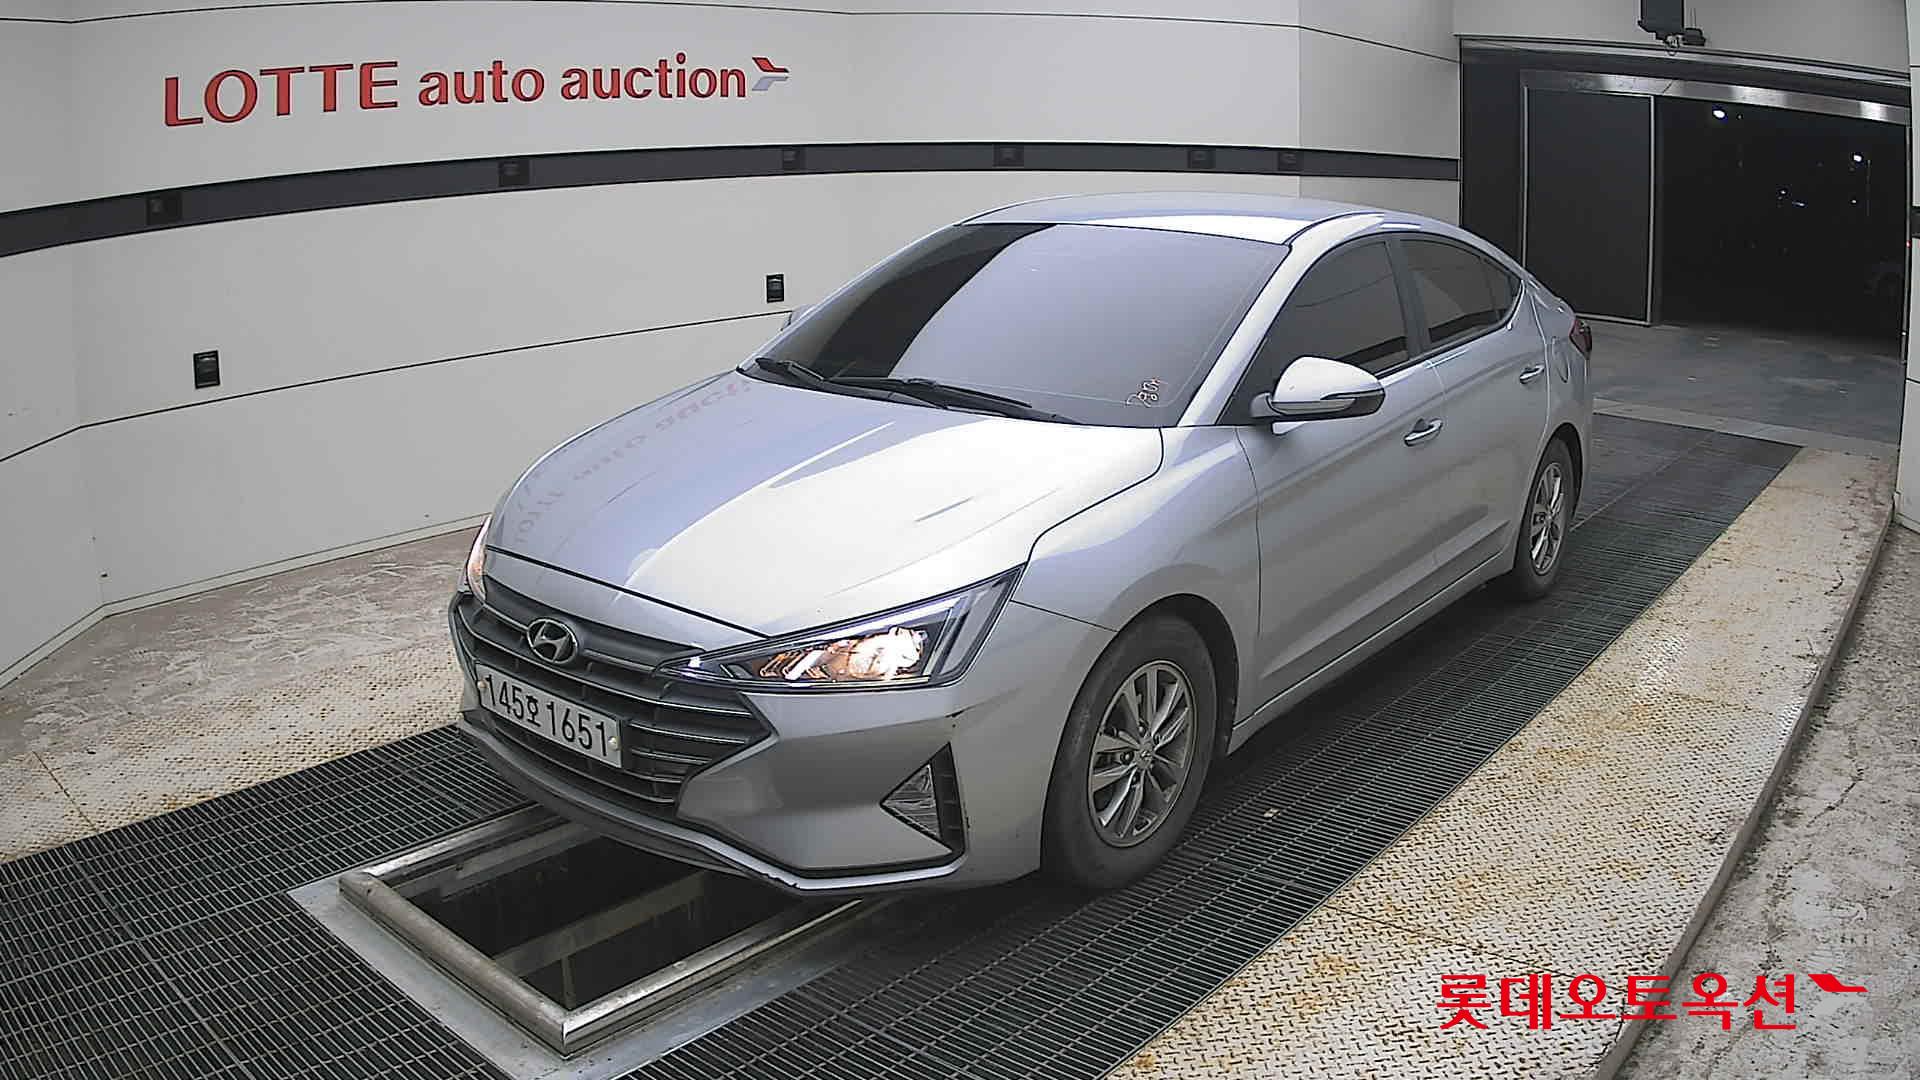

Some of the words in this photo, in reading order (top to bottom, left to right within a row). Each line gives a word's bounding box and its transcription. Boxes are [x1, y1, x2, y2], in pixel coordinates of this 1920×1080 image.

[164, 60, 399, 127] LOTTE
[418, 59, 545, 107] auto
[560, 52, 747, 100] auction
[546, 700, 607, 757] 1651
